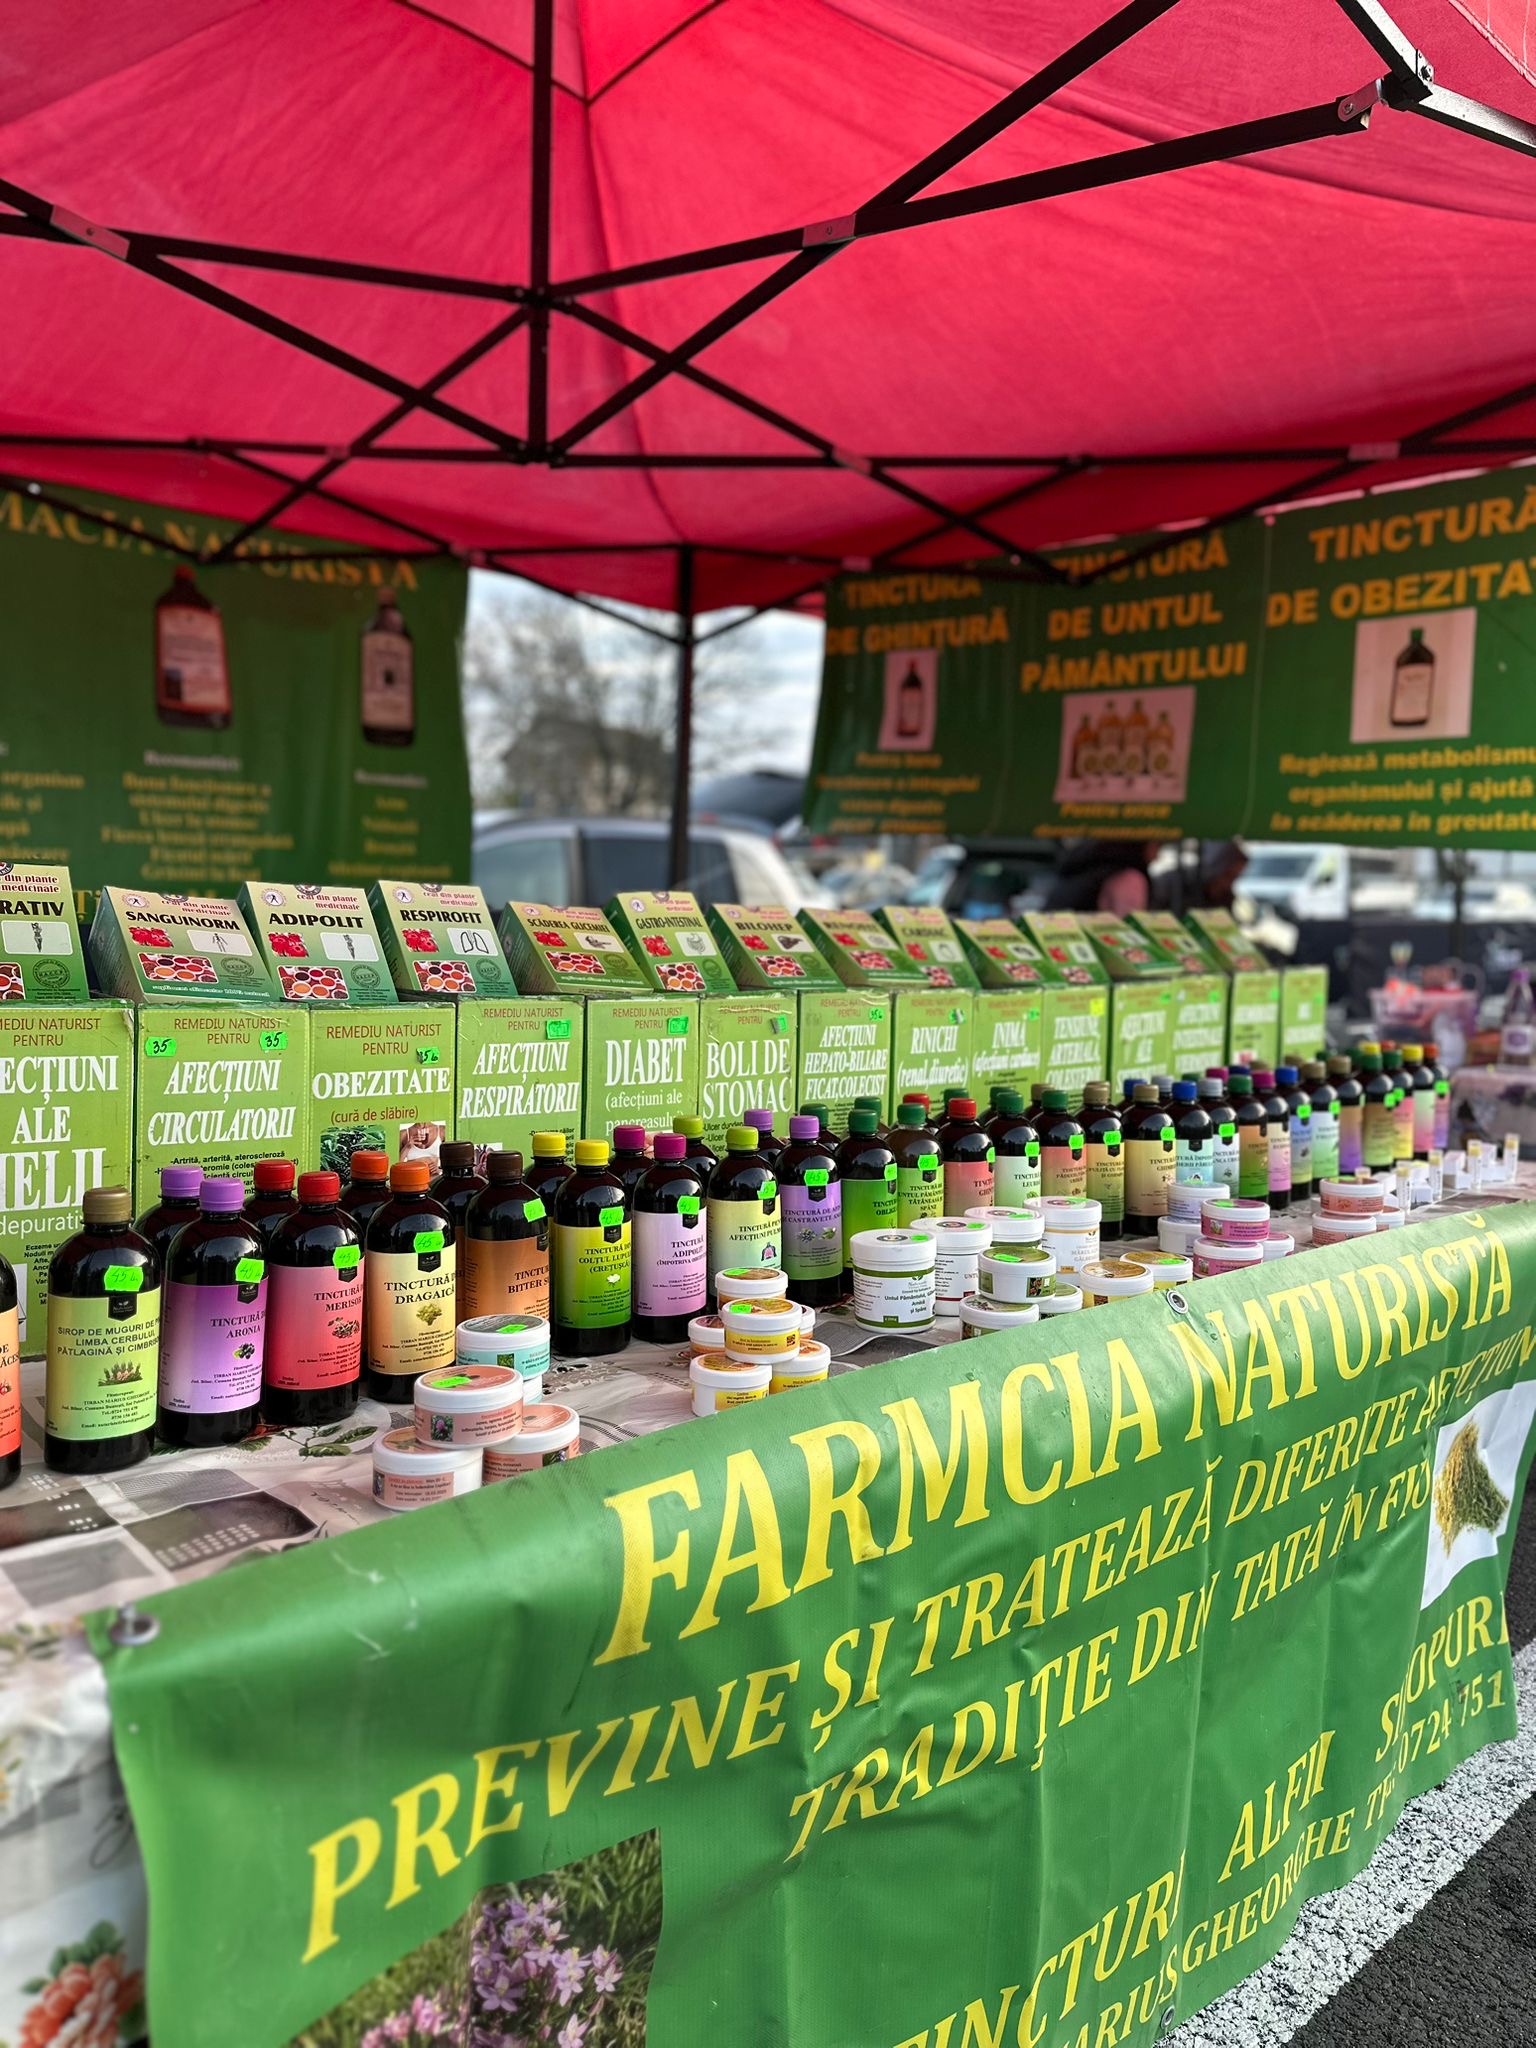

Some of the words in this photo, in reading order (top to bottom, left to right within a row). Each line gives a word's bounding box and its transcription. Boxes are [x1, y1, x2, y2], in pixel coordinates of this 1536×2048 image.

[1048, 606, 1091, 641] DE
[1102, 592, 1222, 635] UNTUL
[1266, 588, 1318, 627] DE
[865, 606, 1009, 653] GHINTURĂ
[1020, 642, 1247, 693] PĂMÂNTULUI
[25, 875, 58, 884] plante
[126, 911, 241, 930] SANGUINORM
[269, 913, 364, 928] ADIPOLIT
[400, 909, 482, 924] RESPIROFIT
[483, 1008, 522, 1018] REMEDIU
[524, 1007, 564, 1018] NATURIST
[612, 1008, 647, 1018] REMEDIU
[0, 1018, 34, 1031] EDIU
[38, 1018, 101, 1031] NATURIST
[174, 1018, 225, 1030] REMEDIU
[228, 1017, 282, 1030] NATURIST
[326, 1026, 381, 1039] REMEDIU
[385, 1023, 442, 1038] NATURIST
[508, 1021, 541, 1031] PENTRU
[634, 1019, 664, 1030] PENTRU
[13, 1034, 64, 1047] PENTRU
[152, 1039, 169, 1055] 35
[207, 1033, 251, 1045] PENTRU
[265, 1032, 283, 1048] 35
[910, 1026, 960, 1054] RINICHI
[362, 1041, 409, 1056] PENTRU
[472, 1041, 571, 1083] AFECȚIUNI
[604, 1037, 688, 1087] DIABET
[706, 1040, 758, 1080] BOLI
[763, 1038, 791, 1074] DE
[164, 1059, 283, 1104] AFECȚIUNI
[311, 1067, 451, 1101] OBEZITATE
[459, 1082, 580, 1119] RESPIRATORII
[605, 1090, 664, 1113] (afecțiuni
[666, 1088, 683, 1105] ale
[703, 1077, 793, 1121] STOMAC
[331, 1108, 361, 1126] (cură
[363, 1108, 378, 1122] de
[380, 1104, 419, 1122] slăbire)
[11, 1106, 71, 1145] ALE
[147, 1106, 297, 1147] CIRCULATORII
[384, 1272, 450, 1291] TINCTURĂ
[508, 1279, 542, 1294] BITTER
[314, 1284, 360, 1301] TINCTURĂ
[58, 1326, 85, 1336] SIROP
[88, 1327, 103, 1336] DE
[105, 1323, 144, 1336] MUGURI
[145, 1320, 155, 1329] DE
[210, 1312, 261, 1328] TINCTURĂ
[76, 1338, 109, 1346] LIMBA
[111, 1329, 155, 1345] CERBULUI
[226, 1325, 261, 1339] ARONIA
[58, 1346, 113, 1357] PĂTLAGINĂ
[115, 1346, 126, 1356] ȘI
[594, 1337, 1162, 1665] FARMCIA
[1168, 1213, 1513, 1443] NATURISTĂ
[301, 1660, 800, 1965] PREVINE
[811, 1617, 896, 1752] ȘI
[911, 1459, 1223, 1679] TRATEAZĂ
[1227, 1388, 1418, 1525] DIFERITE
[785, 1626, 1119, 1866] TRADIȚIE
[1128, 1573, 1220, 1687] DIN
[1232, 1498, 1334, 1622] TATĂ
[1458, 1670, 1506, 1728] 751
